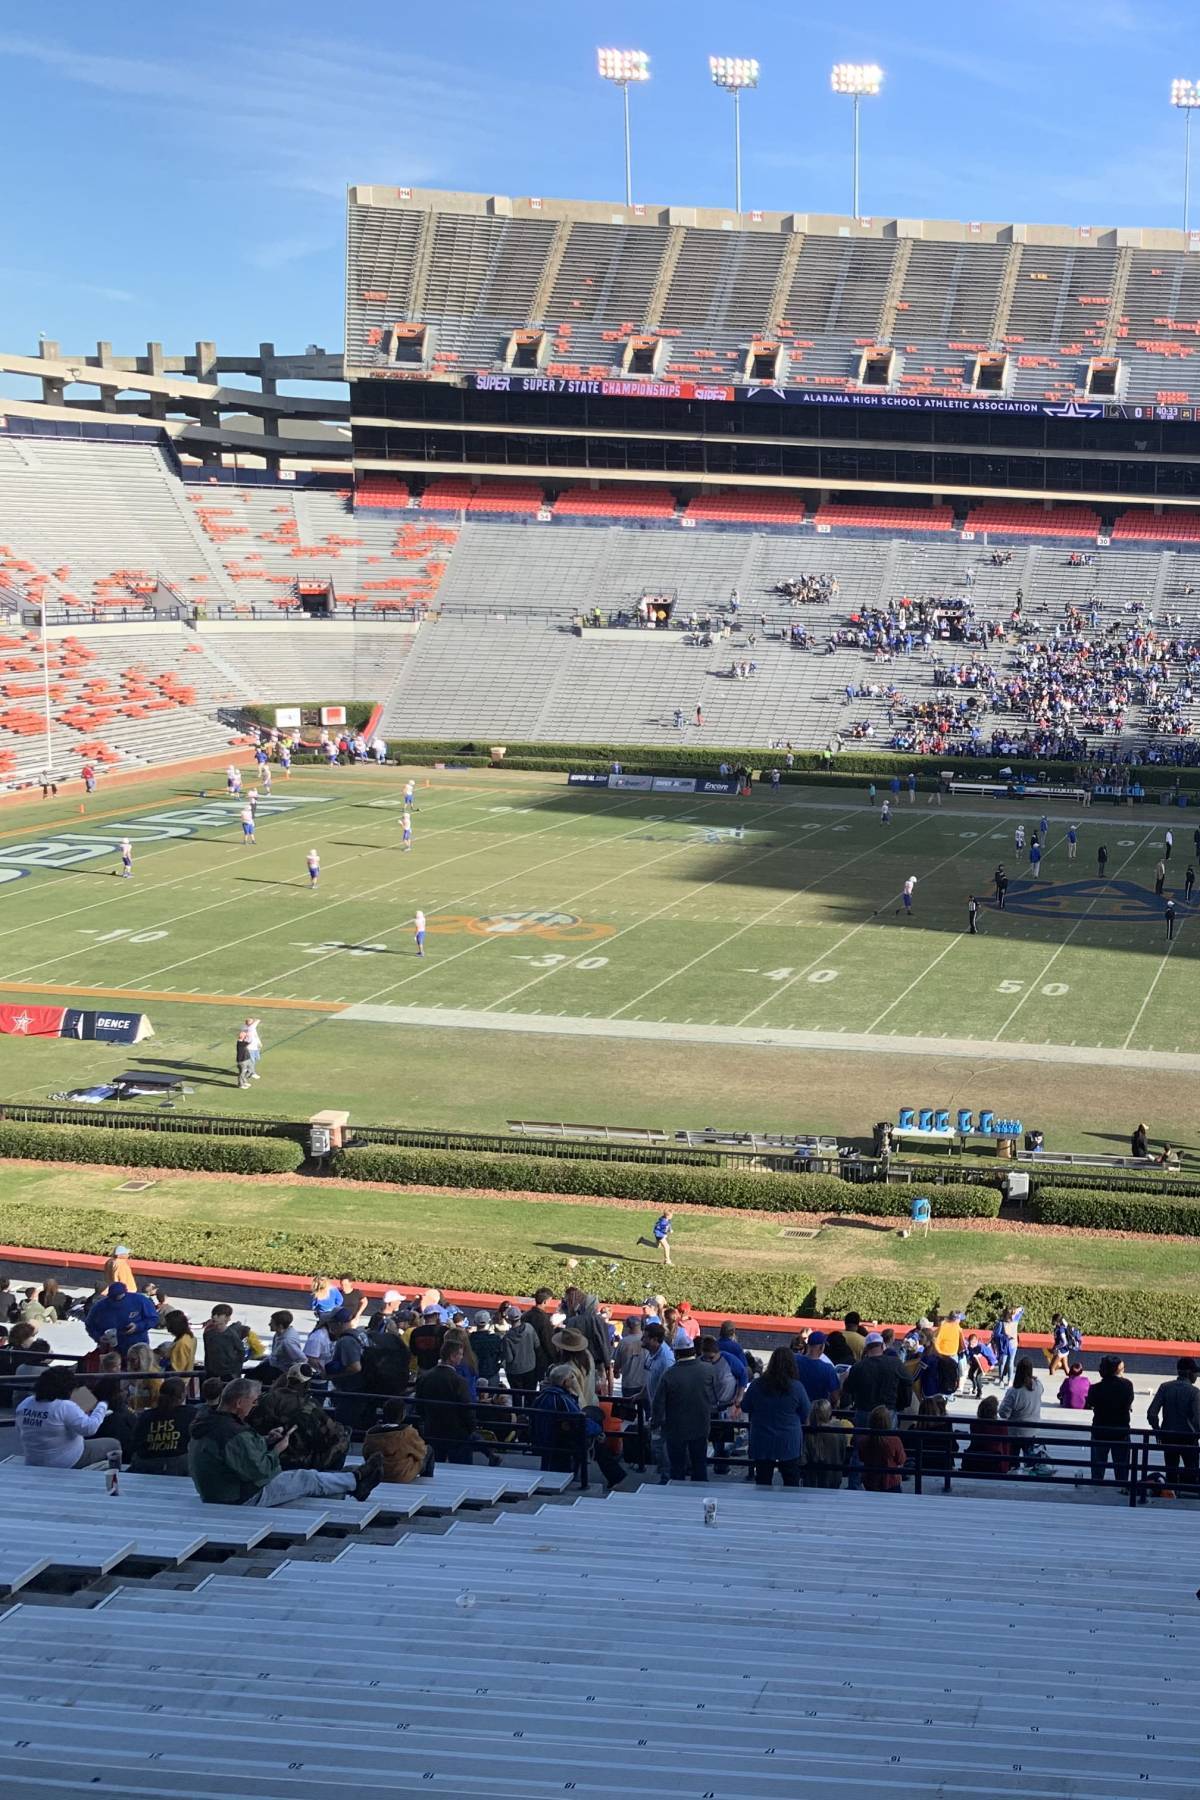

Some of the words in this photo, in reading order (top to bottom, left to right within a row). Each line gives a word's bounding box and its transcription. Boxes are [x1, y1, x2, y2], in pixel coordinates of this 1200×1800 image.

[523, 378, 556, 392] SUPER
[558, 379, 565, 392] 7
[568, 380, 599, 394] STATE
[602, 382, 681, 397] CHAMPIONSHIPS
[803, 393, 850, 403] ALABAMA
[852, 395, 878, 405] HIGH
[881, 396, 922, 407] SCHOOL
[924, 399, 970, 409] ATHLETIC
[972, 401, 1038, 412] ASSOCIATION
[1156, 407, 1178, 416] 40:33
[704, 782, 729, 792] Encore
[530, 954, 610, 970] 30
[762, 967, 840, 983] 40
[995, 979, 1071, 996] 50
[96, 1017, 132, 1029] DENCE
[23, 1408, 49, 1420] TANKS
[22, 1417, 43, 1428] MOM
[150, 1419, 175, 1433] LHS
[147, 1431, 181, 1442] BAND
